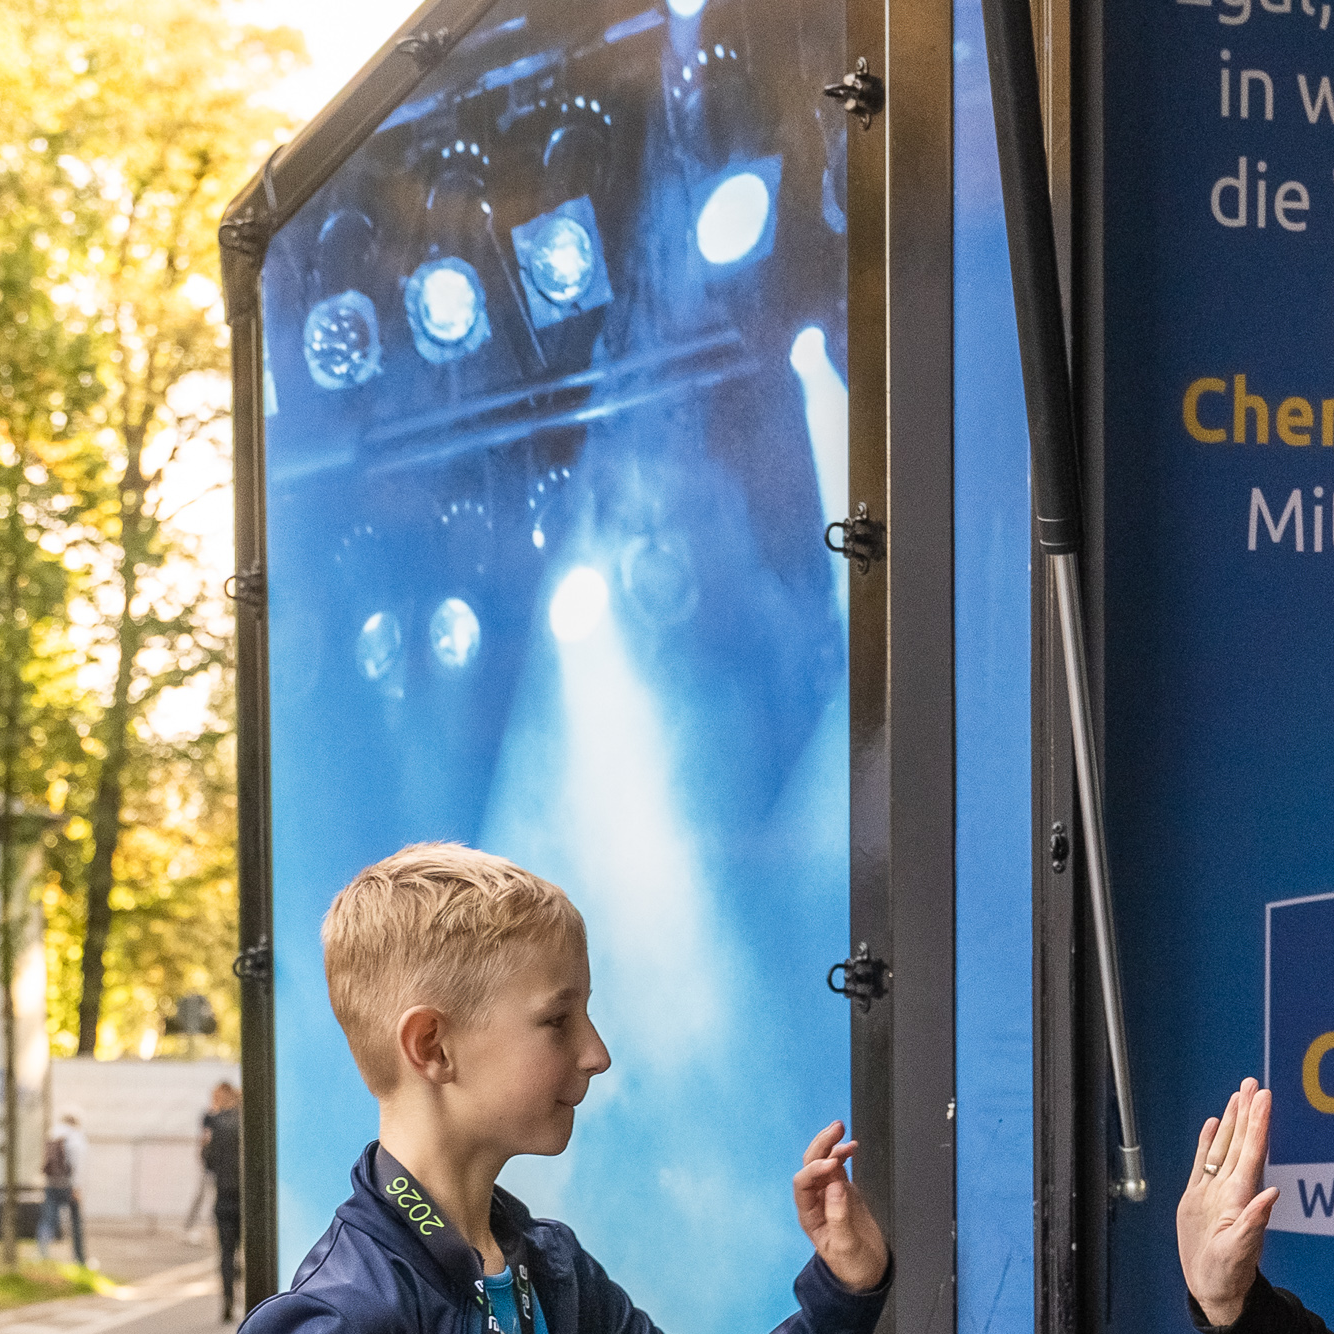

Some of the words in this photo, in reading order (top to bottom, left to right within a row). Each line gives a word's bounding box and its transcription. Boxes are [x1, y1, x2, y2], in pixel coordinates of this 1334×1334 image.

[1221, 50, 1274, 119] in
[1212, 157, 1309, 231] die
[386, 1176, 445, 1236] 2026
